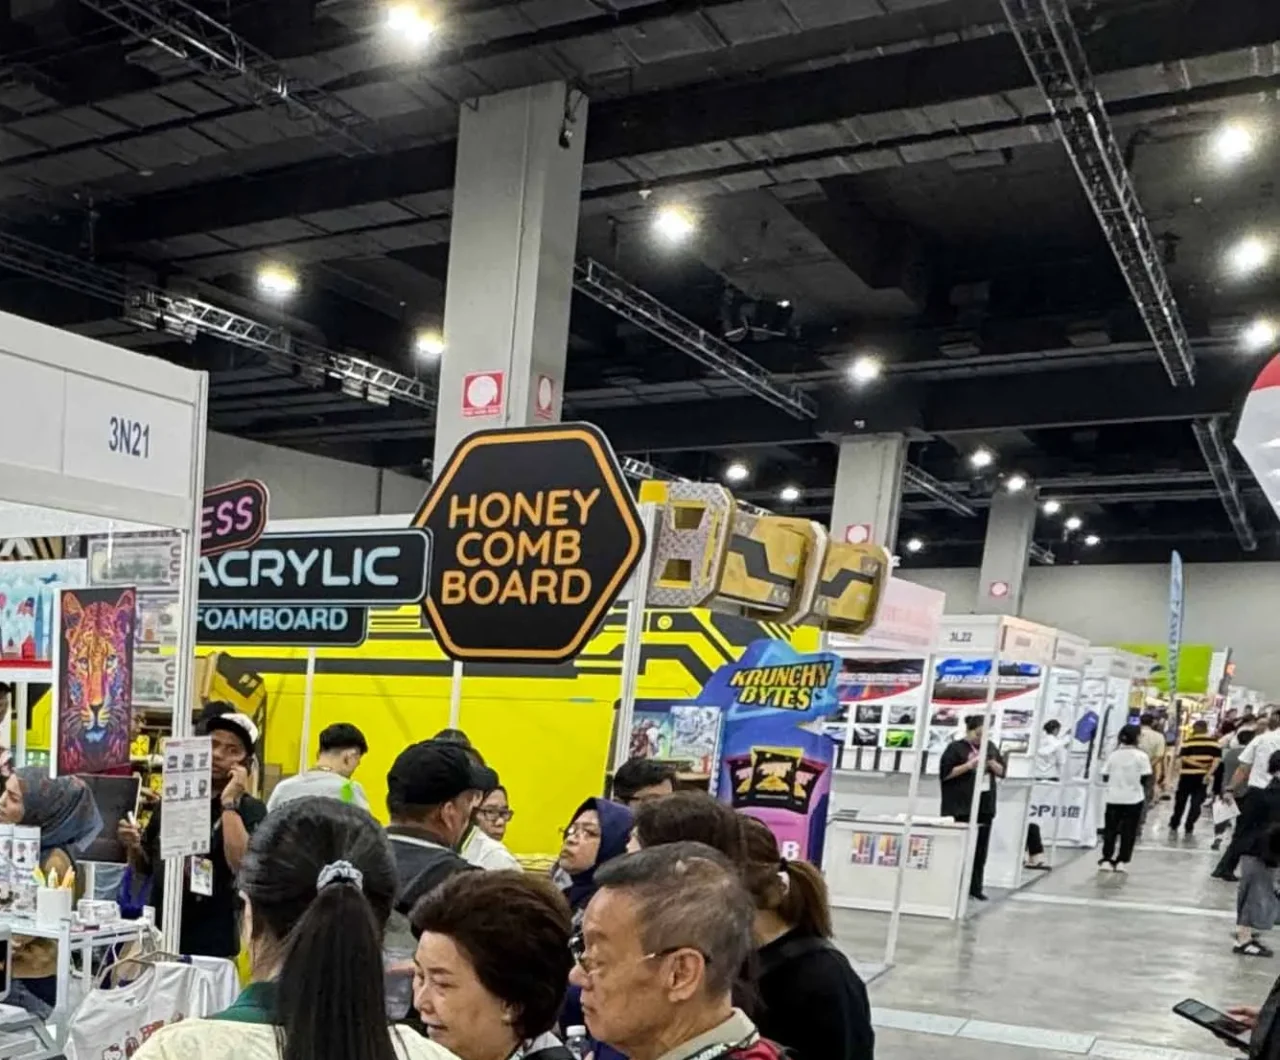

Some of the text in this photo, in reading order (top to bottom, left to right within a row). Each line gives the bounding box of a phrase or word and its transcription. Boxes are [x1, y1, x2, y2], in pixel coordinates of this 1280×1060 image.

[108, 415, 151, 460] 3N21
[449, 488, 600, 528] HONEY
[198, 547, 401, 587] ACRYLIC
[456, 529, 581, 567] COMB
[441, 569, 592, 605] BOARD
[730, 662, 833, 688] KRUNCHY
[739, 686, 812, 710] BYTES
